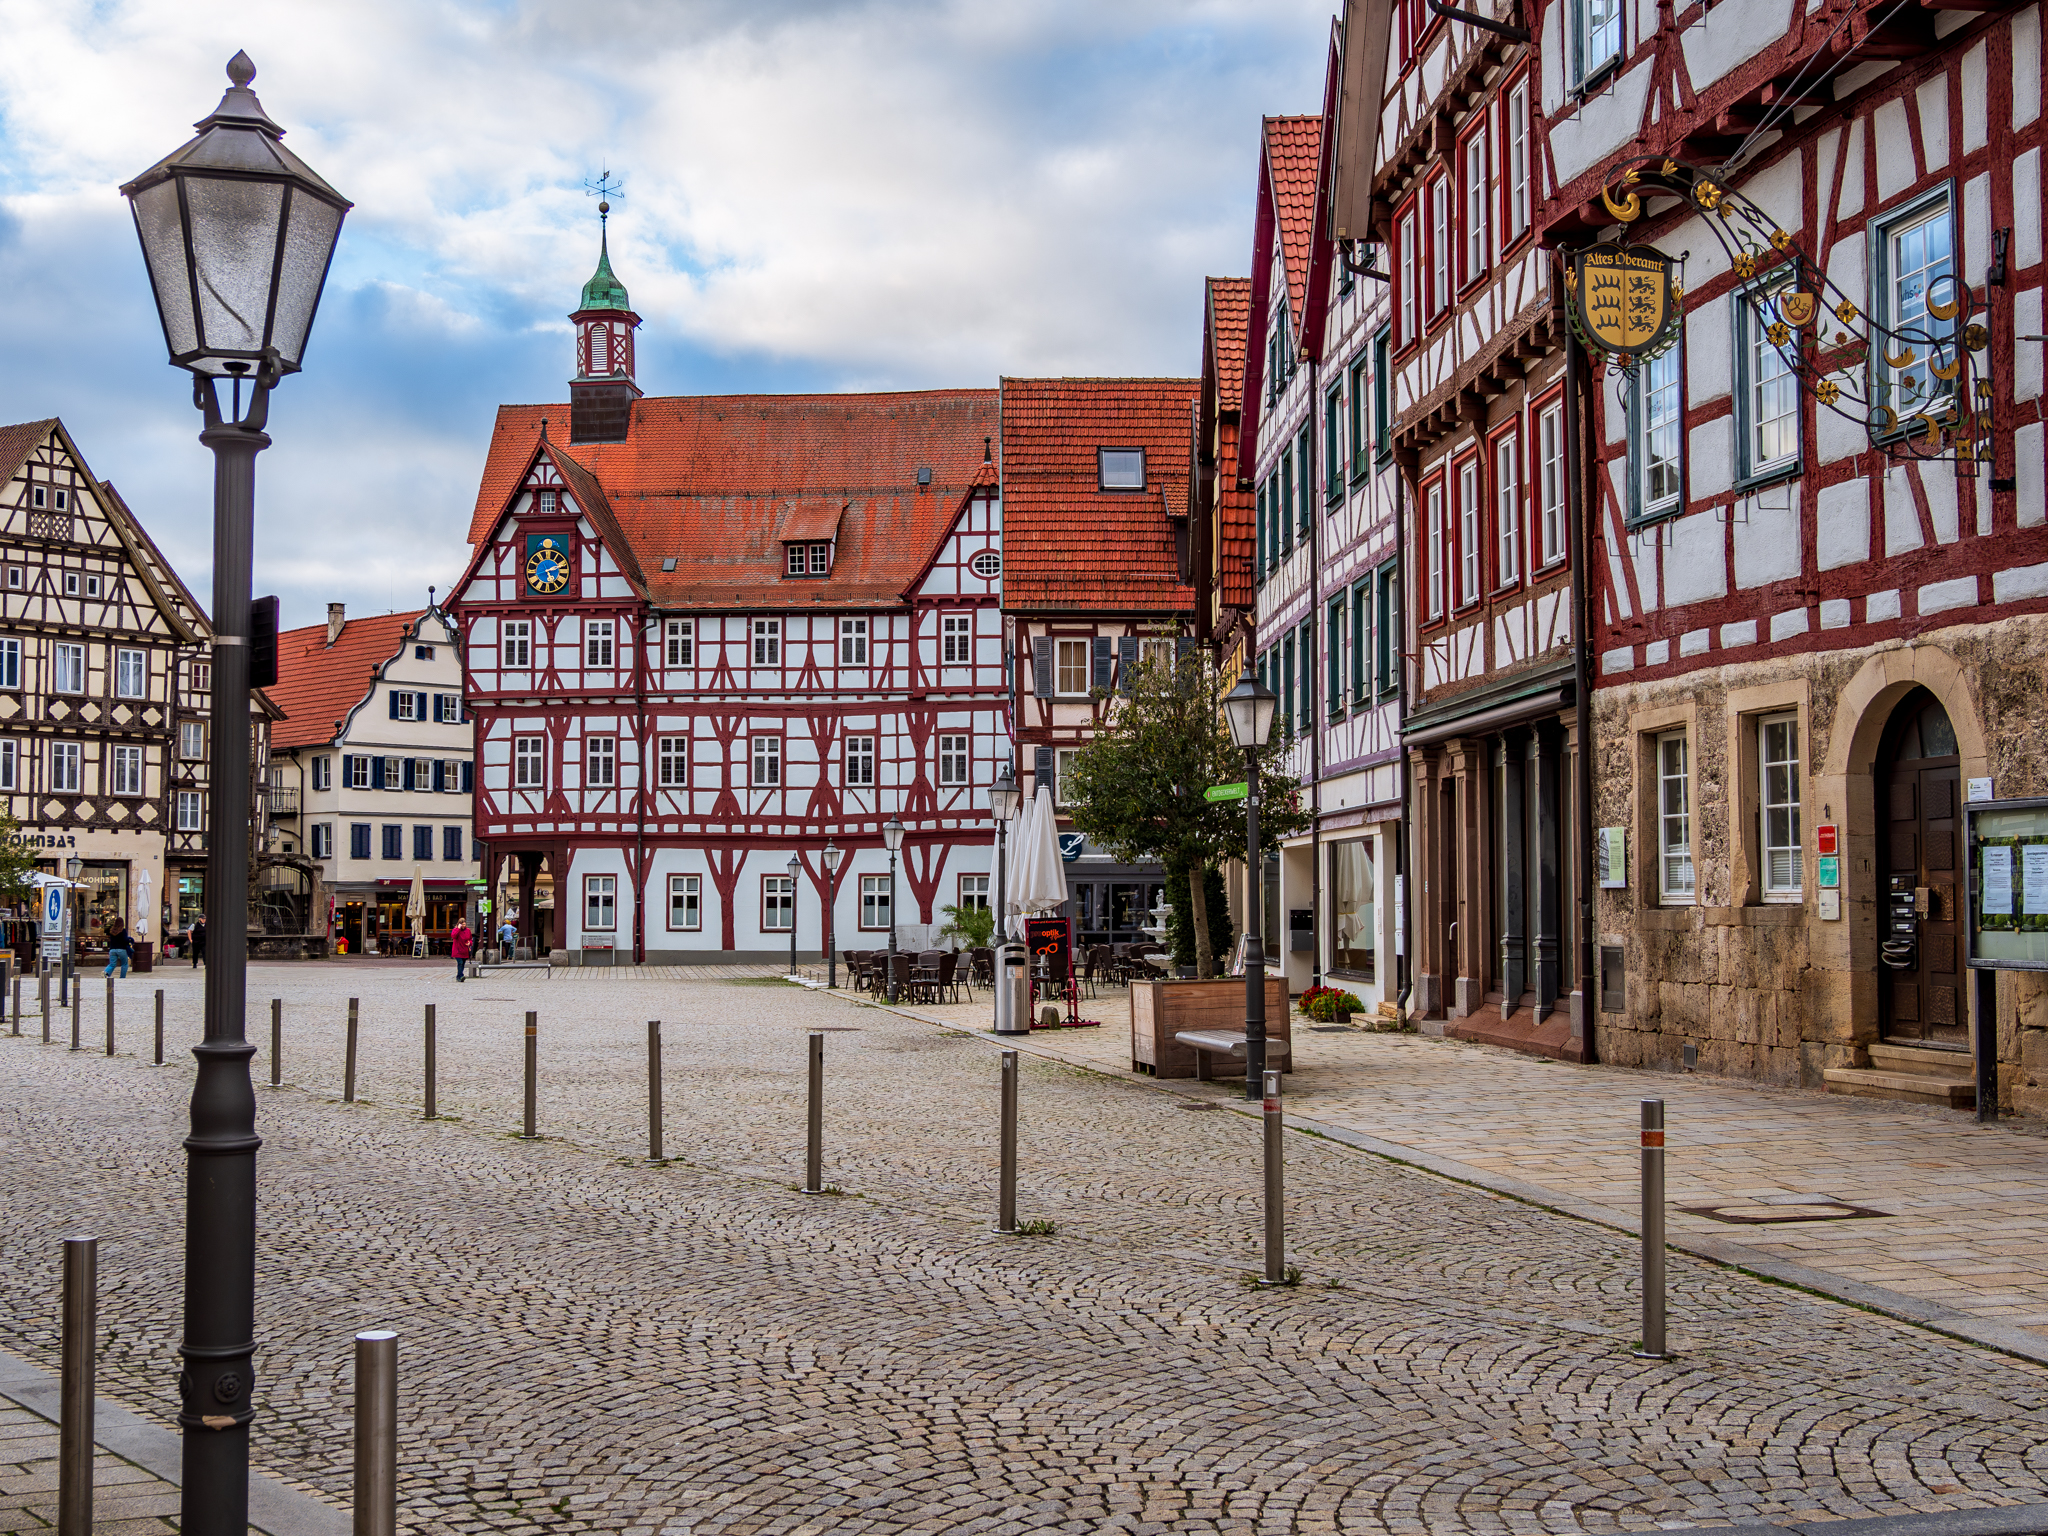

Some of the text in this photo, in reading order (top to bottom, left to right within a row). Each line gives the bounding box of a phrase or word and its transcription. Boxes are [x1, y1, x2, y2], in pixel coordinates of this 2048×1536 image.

[1583, 252, 1665, 272] Altes Oberamt
[48, 923, 58, 931] ZONE
